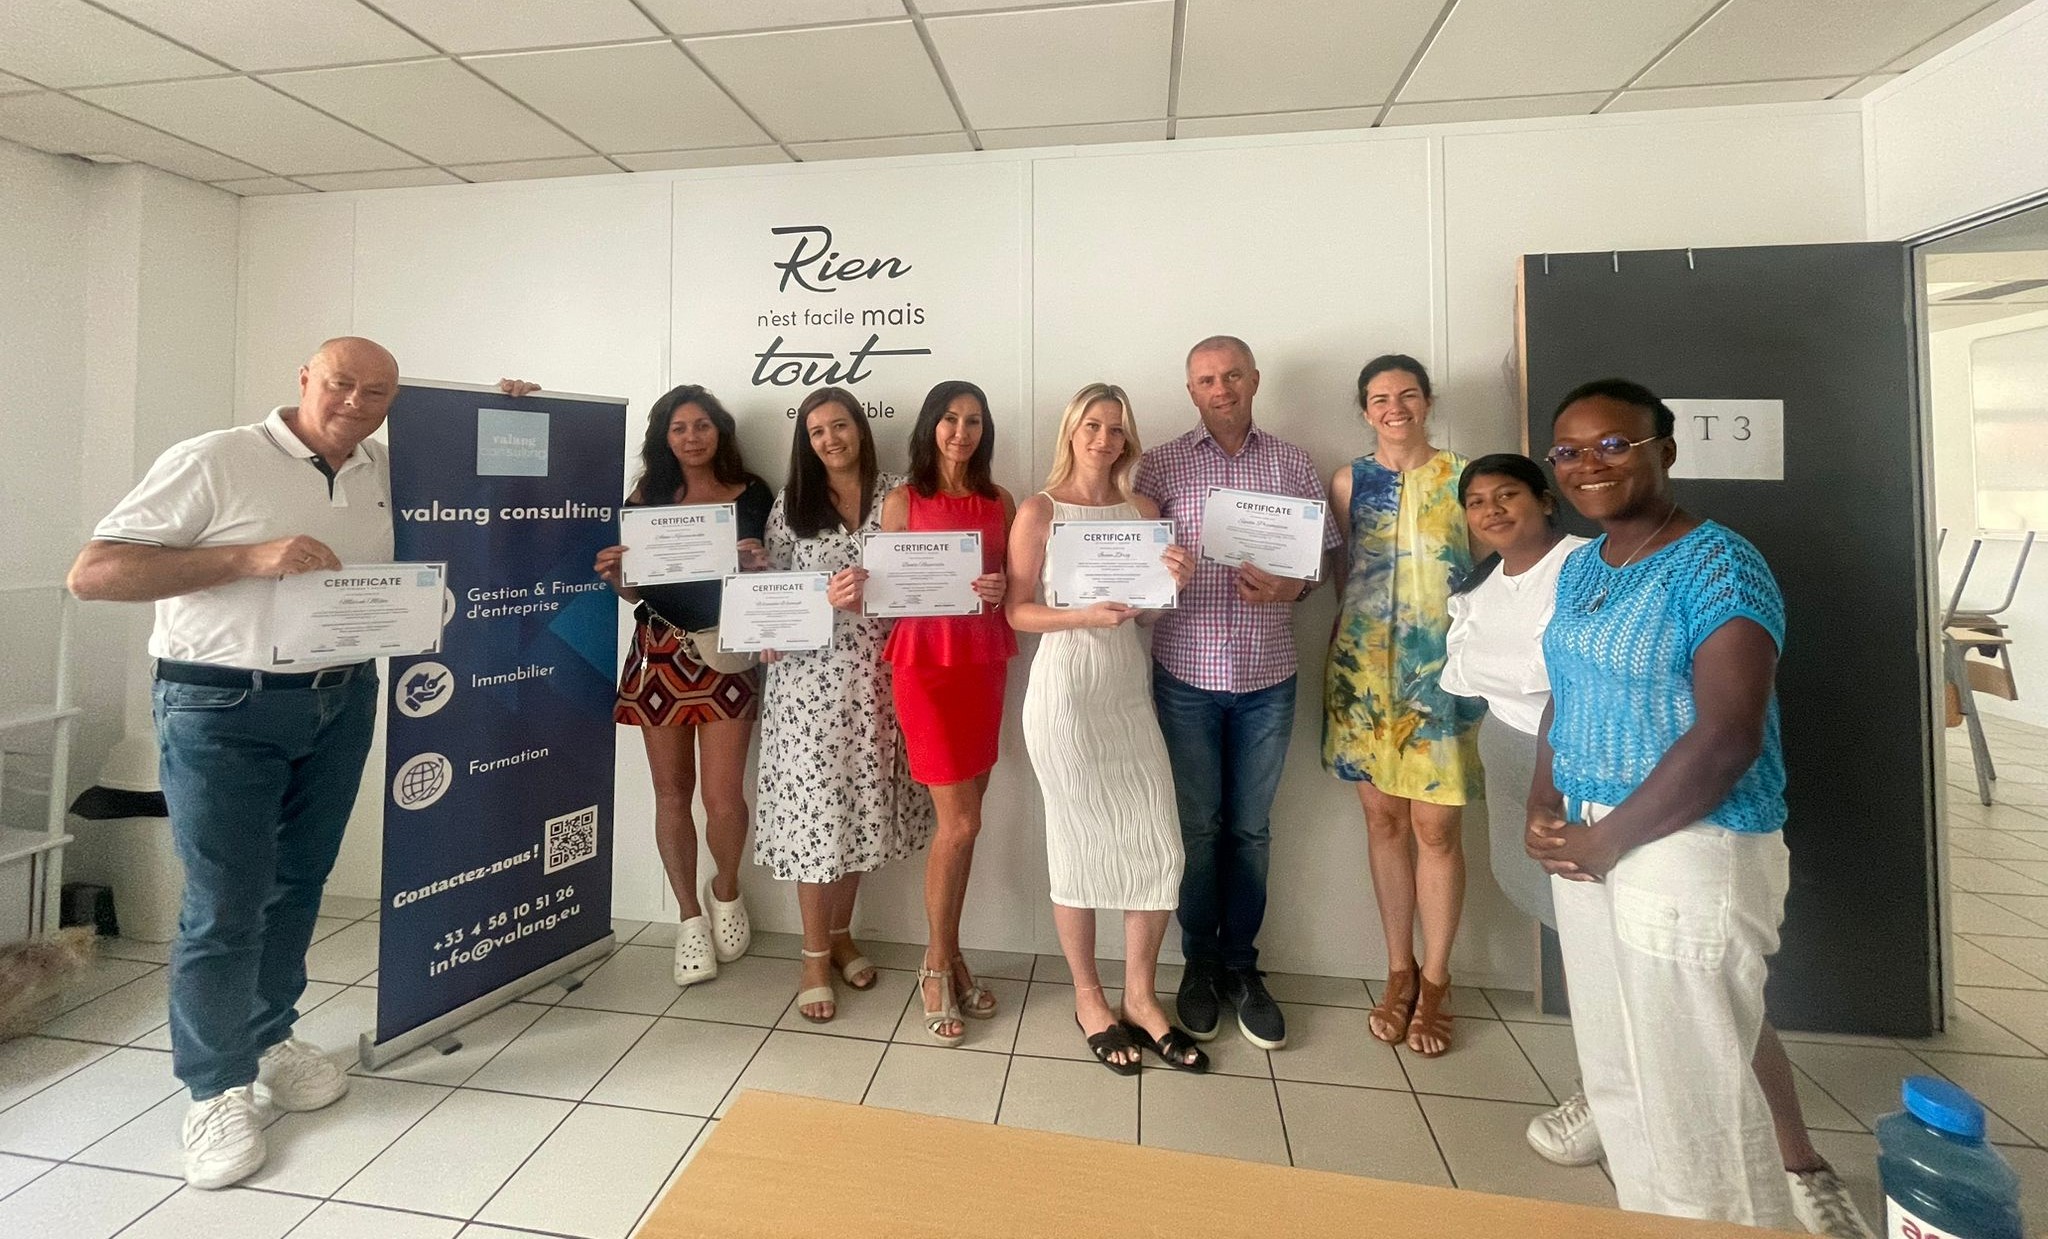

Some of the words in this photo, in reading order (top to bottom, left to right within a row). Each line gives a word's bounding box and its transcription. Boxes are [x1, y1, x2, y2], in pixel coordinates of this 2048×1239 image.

[771, 225, 912, 293] Rien
[757, 310, 797, 327] n'est
[804, 308, 855, 325] facile
[862, 302, 925, 326] mais
[751, 333, 931, 386] tout
[1693, 415, 1719, 441] T
[1732, 415, 1751, 441] 3
[401, 500, 490, 525] valang
[500, 500, 612, 522] consulting
[651, 516, 705, 526] CERTIFICATE
[1236, 501, 1292, 516] CERTIFICATE
[894, 543, 949, 552] CERTIFICATE
[1083, 533, 1141, 541] CERTIFICATE
[324, 577, 401, 588] CERTIFICATE
[467, 587, 528, 602] Gestion
[534, 582, 545, 596] &
[552, 580, 607, 595] Finance
[752, 583, 803, 592] CERTIFICATE
[466, 600, 559, 619] d'entreprise
[471, 663, 555, 688] Immobilier
[469, 747, 549, 775] Formation
[433, 929, 464, 951] +33
[470, 924, 482, 937] 4
[487, 912, 508, 931] 58
[513, 903, 530, 919] 10
[535, 894, 550, 910] 51
[556, 885, 574, 903] 26
[429, 903, 581, 977] info@valang.eu
